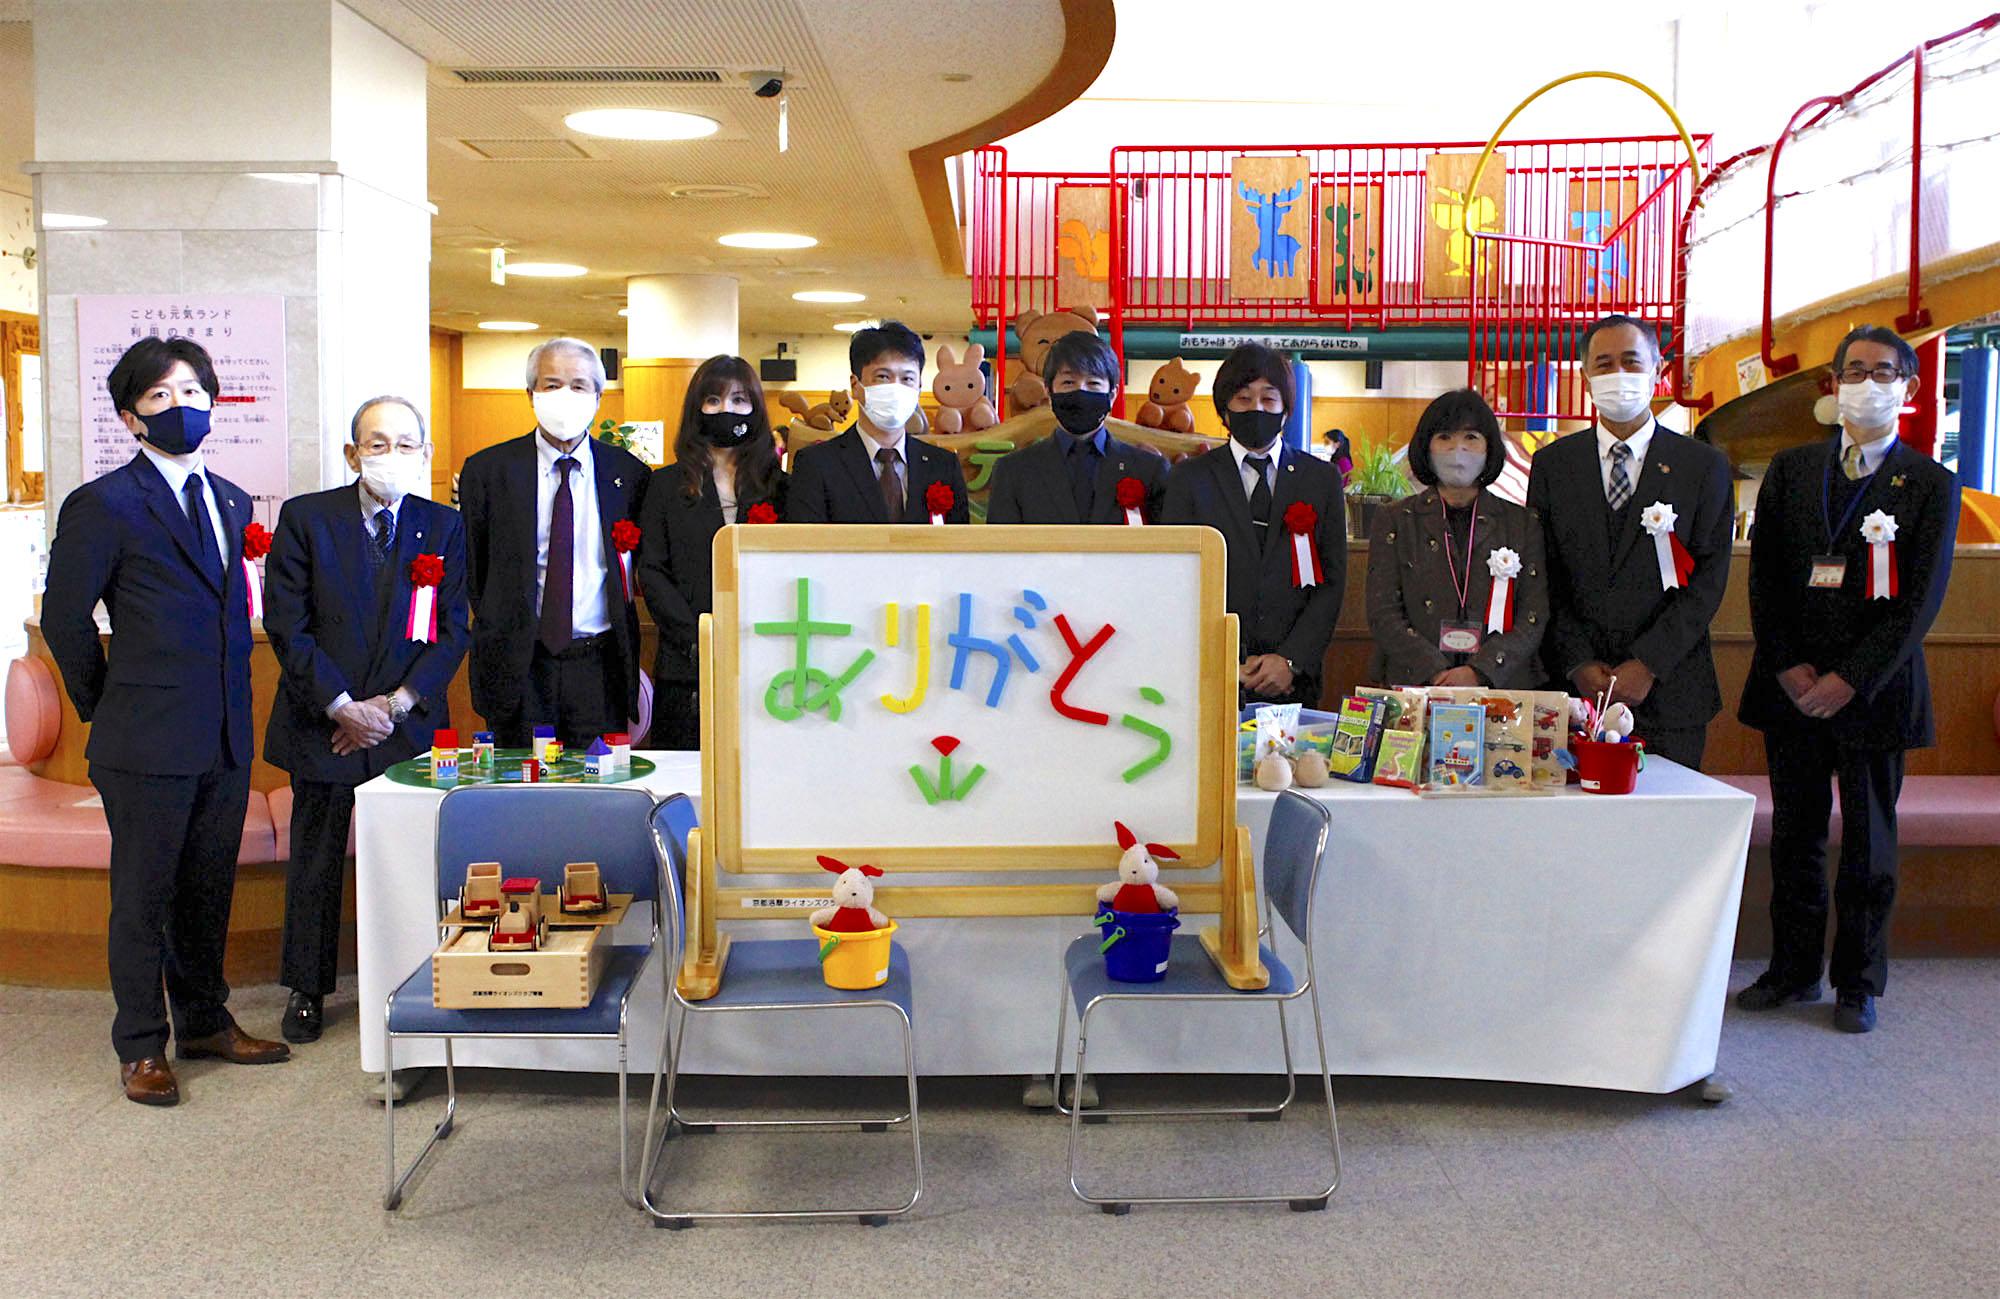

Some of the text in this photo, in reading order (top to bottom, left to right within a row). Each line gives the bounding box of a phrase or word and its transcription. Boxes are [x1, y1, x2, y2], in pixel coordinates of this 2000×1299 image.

[131, 309, 232, 320] こども元気ランド
[131, 327, 232, 337] 利用のきまり
[754, 577, 1171, 783] ありがとう
